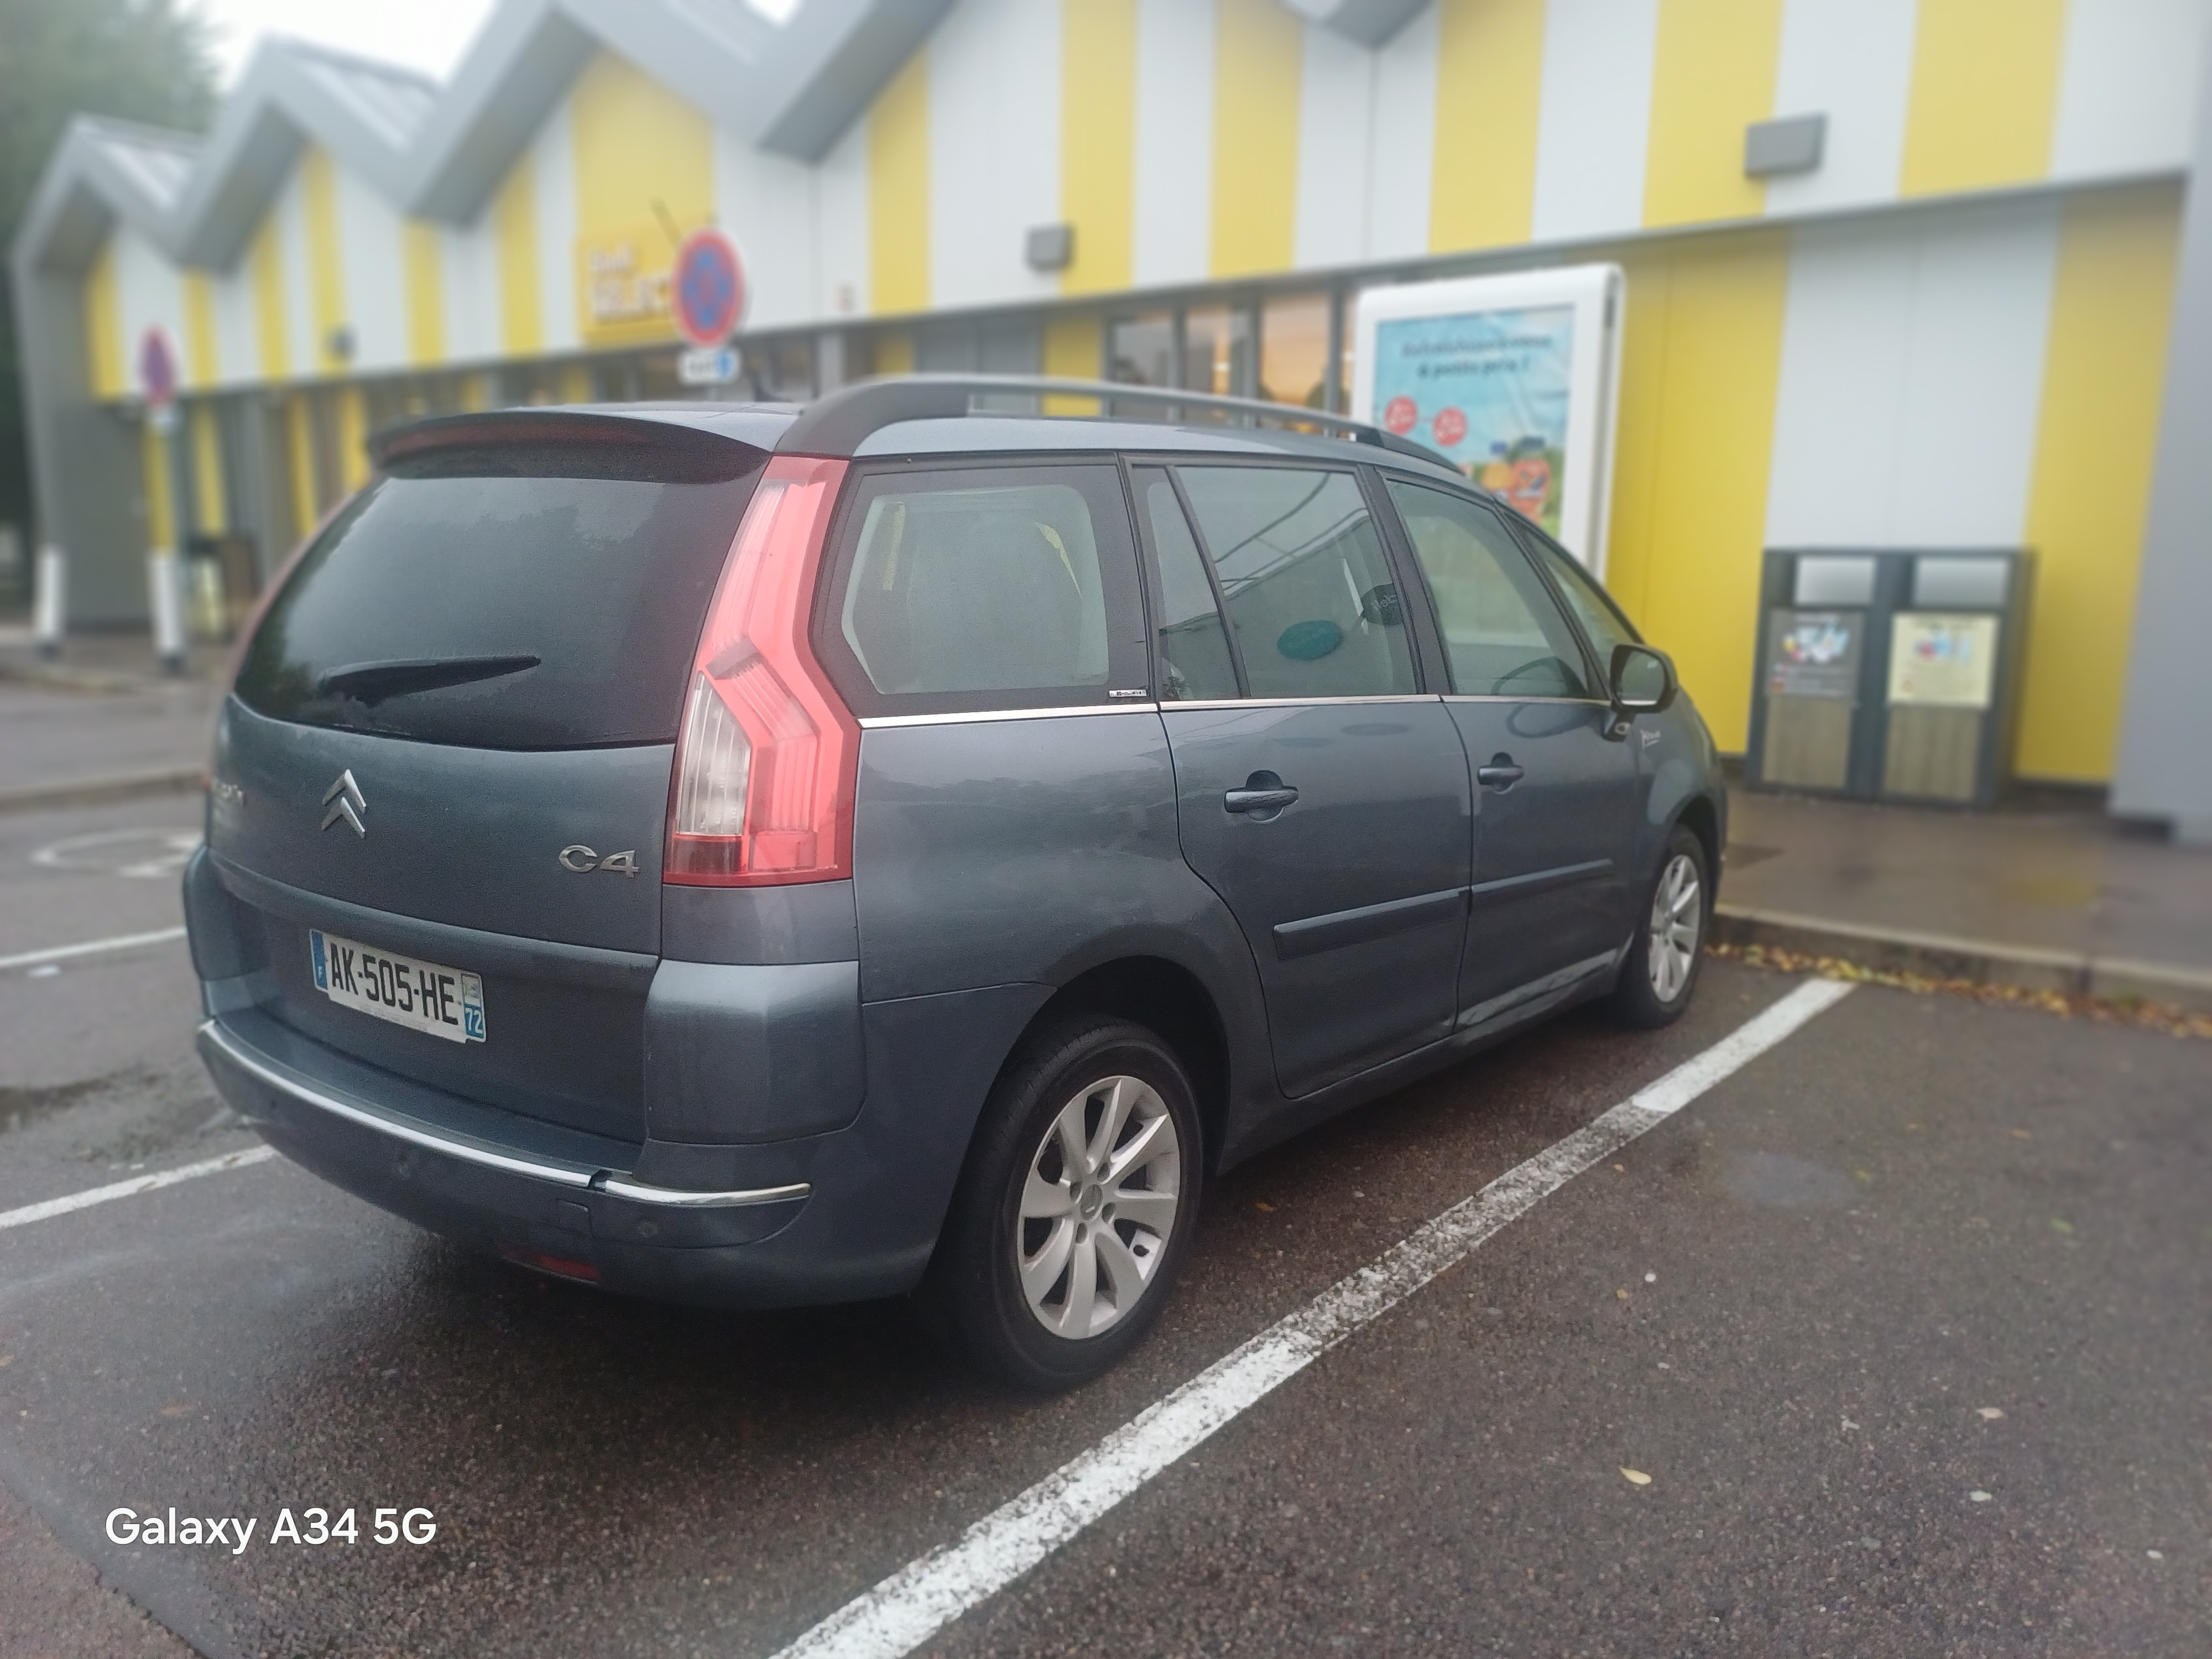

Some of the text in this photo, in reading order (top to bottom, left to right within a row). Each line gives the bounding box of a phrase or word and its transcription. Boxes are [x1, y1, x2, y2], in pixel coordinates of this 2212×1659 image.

[559, 844, 639, 879] C4
[330, 942, 458, 1025] AK-505-HE
[465, 1007, 483, 1034] 72
